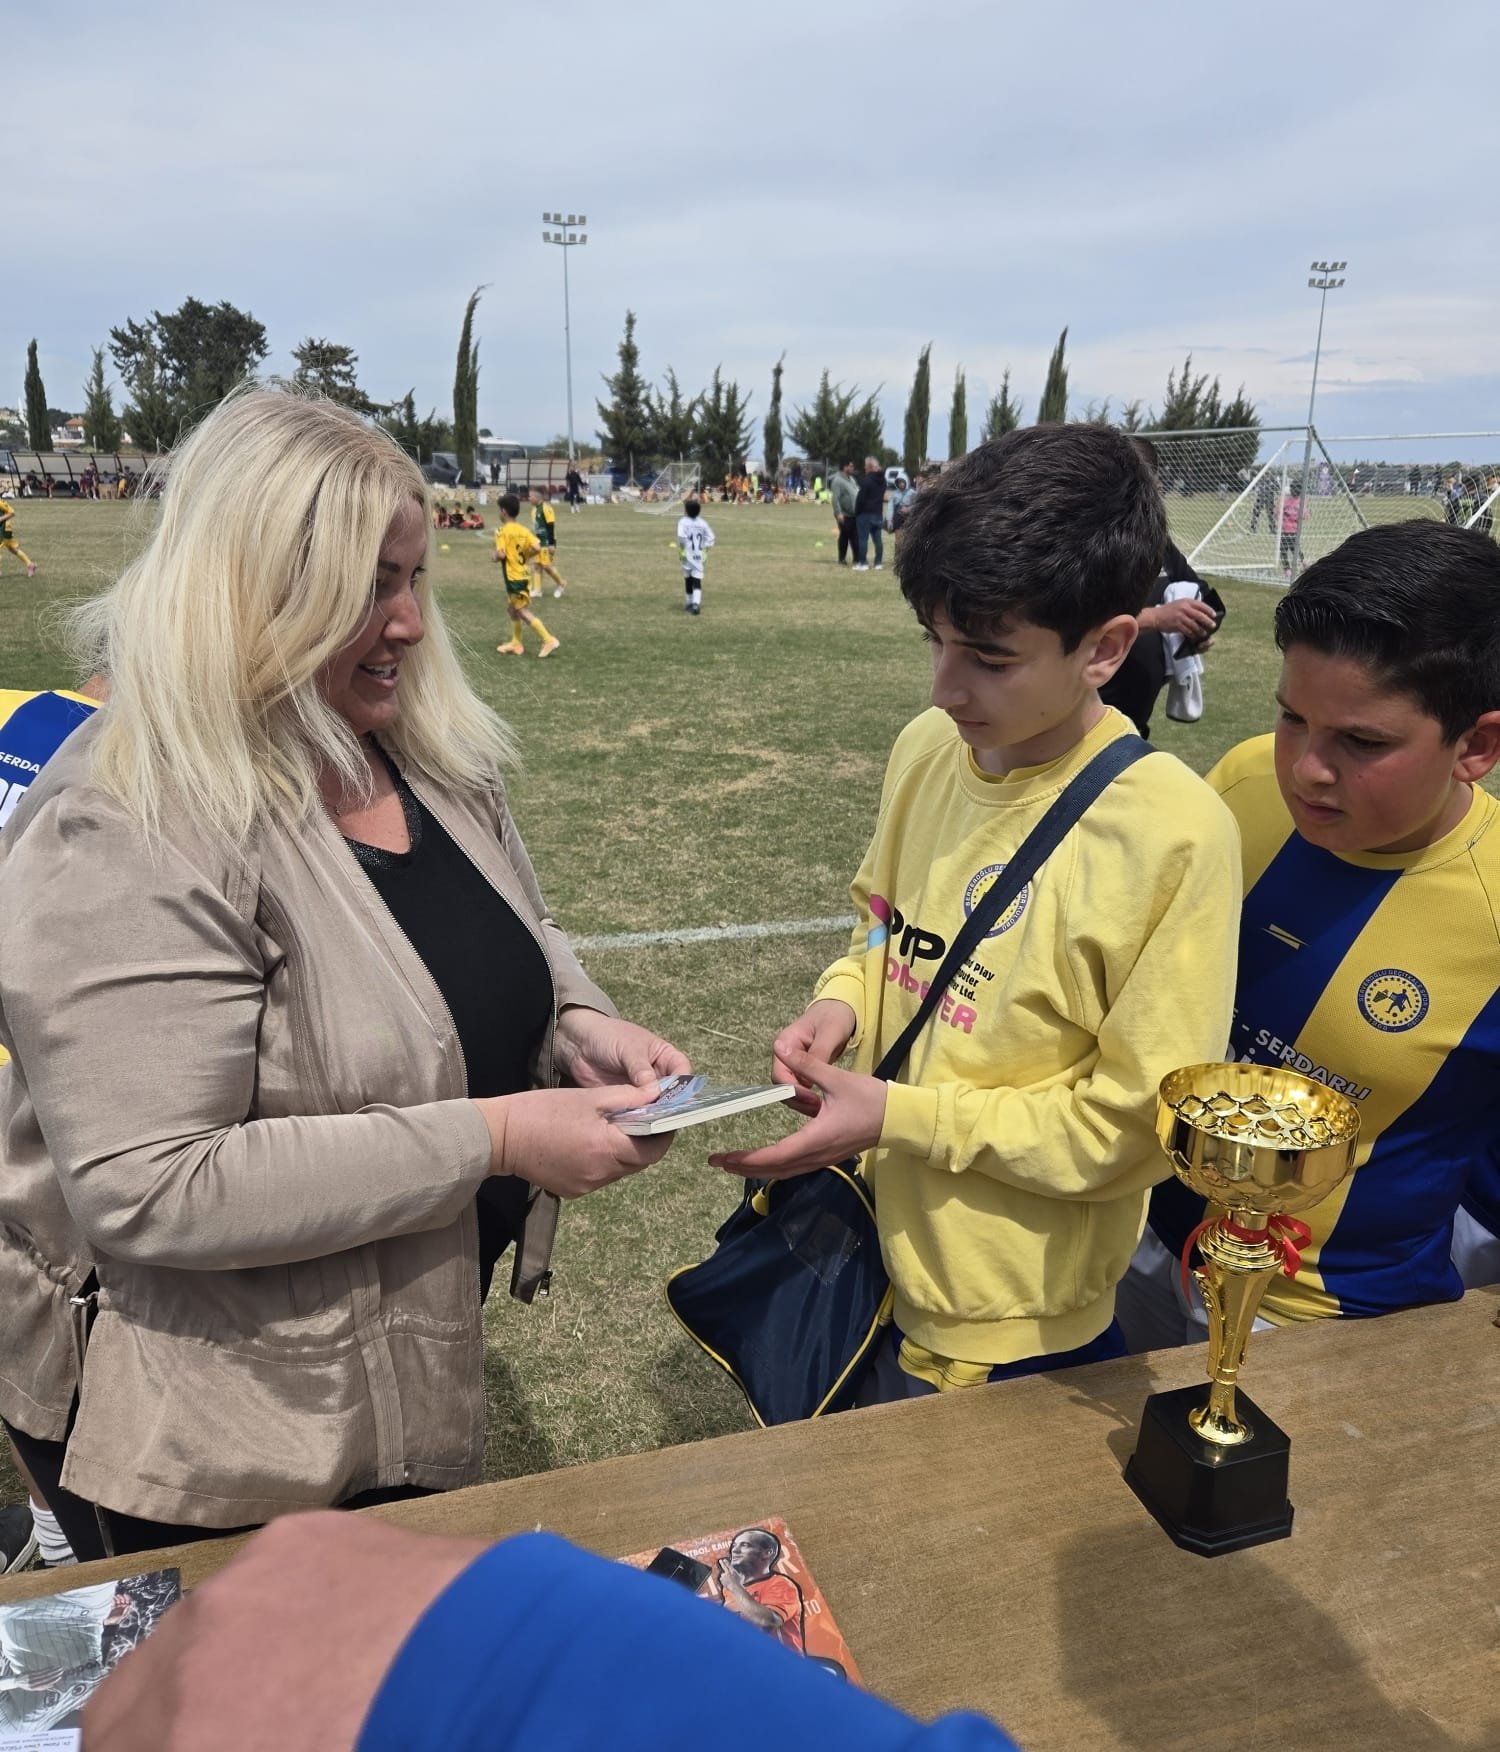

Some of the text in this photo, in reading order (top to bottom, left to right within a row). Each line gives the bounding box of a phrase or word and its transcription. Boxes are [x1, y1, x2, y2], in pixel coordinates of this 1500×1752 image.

[0, 752, 40, 774] SERDA
[973, 962, 995, 981] Play
[959, 985, 976, 1002] Ltd.
[1255, 1029, 1371, 1100] SERDARLI
